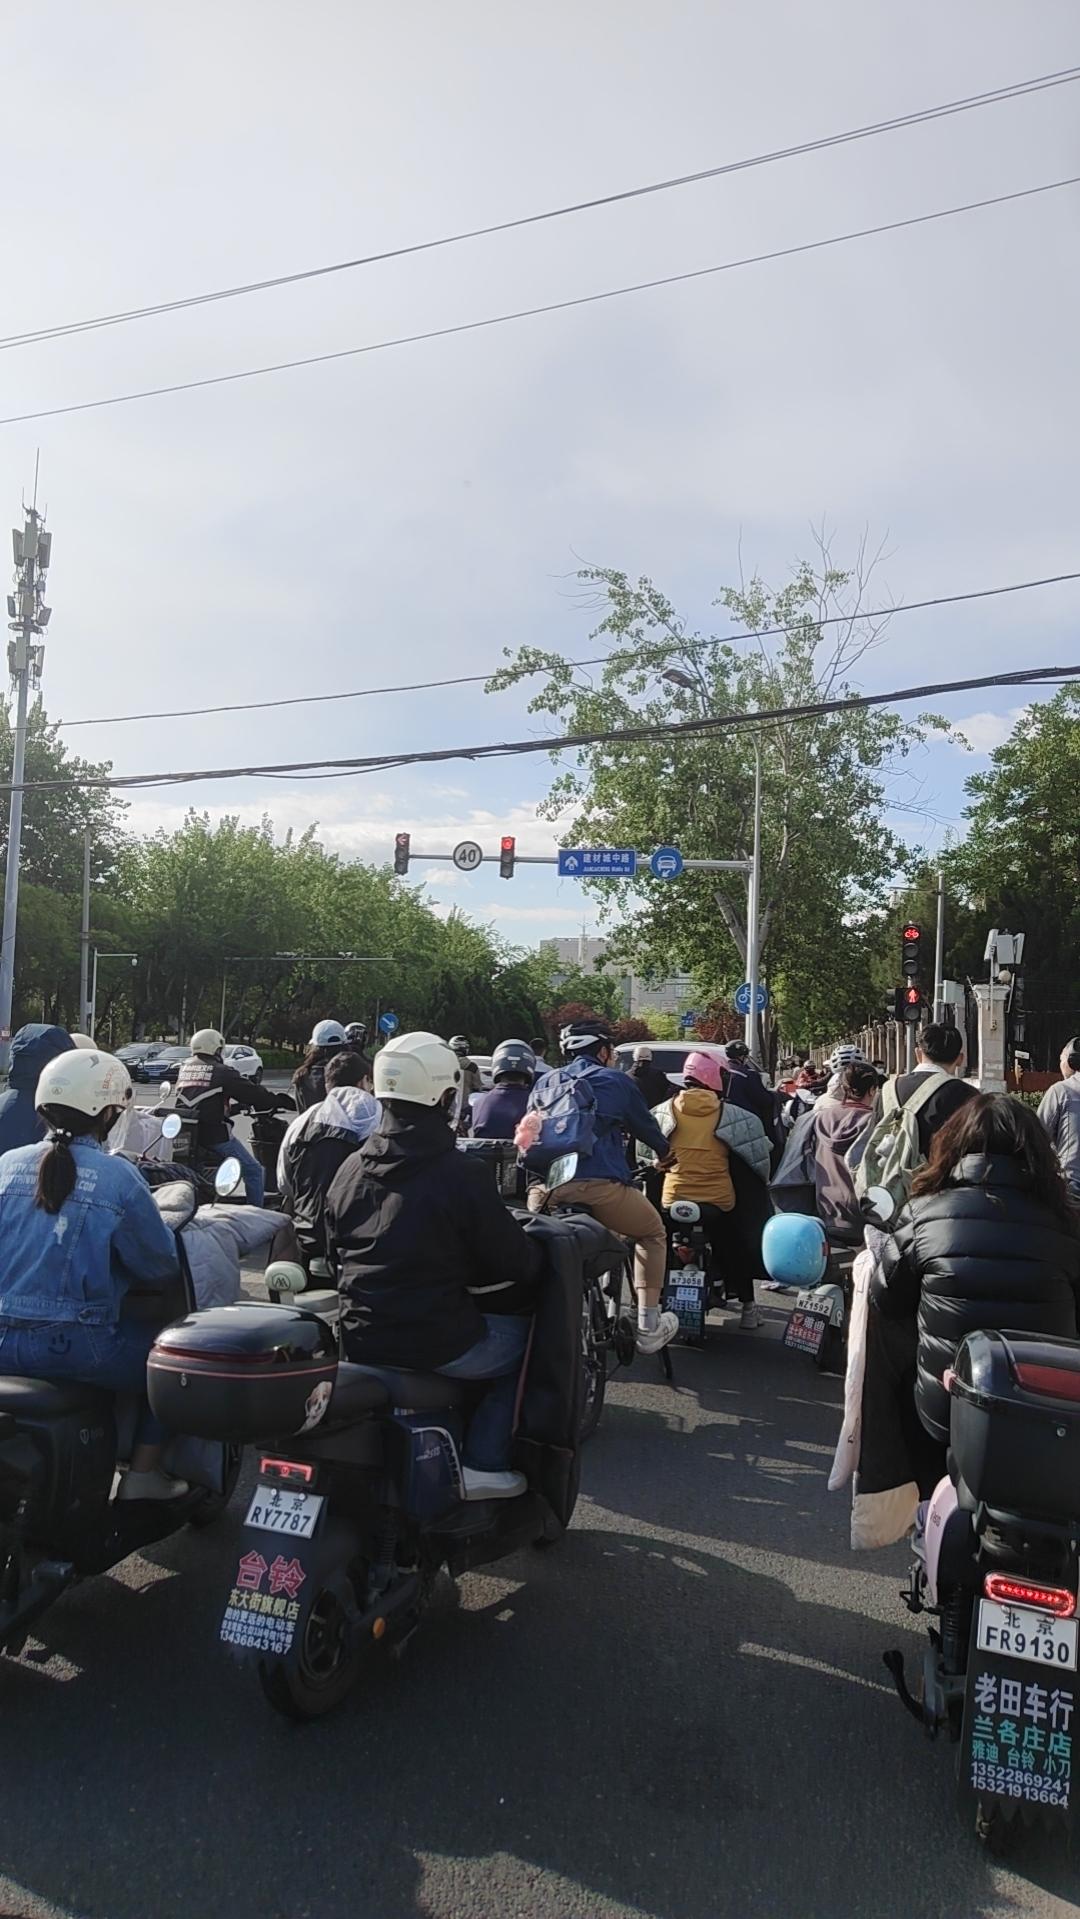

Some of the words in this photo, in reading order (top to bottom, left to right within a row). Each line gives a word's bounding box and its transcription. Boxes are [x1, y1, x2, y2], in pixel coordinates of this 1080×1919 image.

[458, 848, 476, 863] 40
[583, 852, 629, 864] 建材城中路
[250, 1506, 311, 1533] RY7787
[269, 1496, 303, 1511] 北京
[236, 1550, 307, 1599] 台铃
[228, 1588, 300, 1621] 东大街旗舰店
[1003, 1612, 1055, 1636] 北京
[219, 1630, 292, 1655] 13436843167
[985, 1626, 1070, 1664] FR9130
[974, 1671, 1074, 1731] 老田车行
[972, 1715, 1073, 1758] 兰各庄店
[971, 1739, 999, 1765] 雅迪
[1007, 1747, 1036, 1772] 台铃
[1043, 1755, 1071, 1779] 小刀
[970, 1761, 1071, 1795] 13522869241
[970, 1775, 1069, 1810] 15321913664
